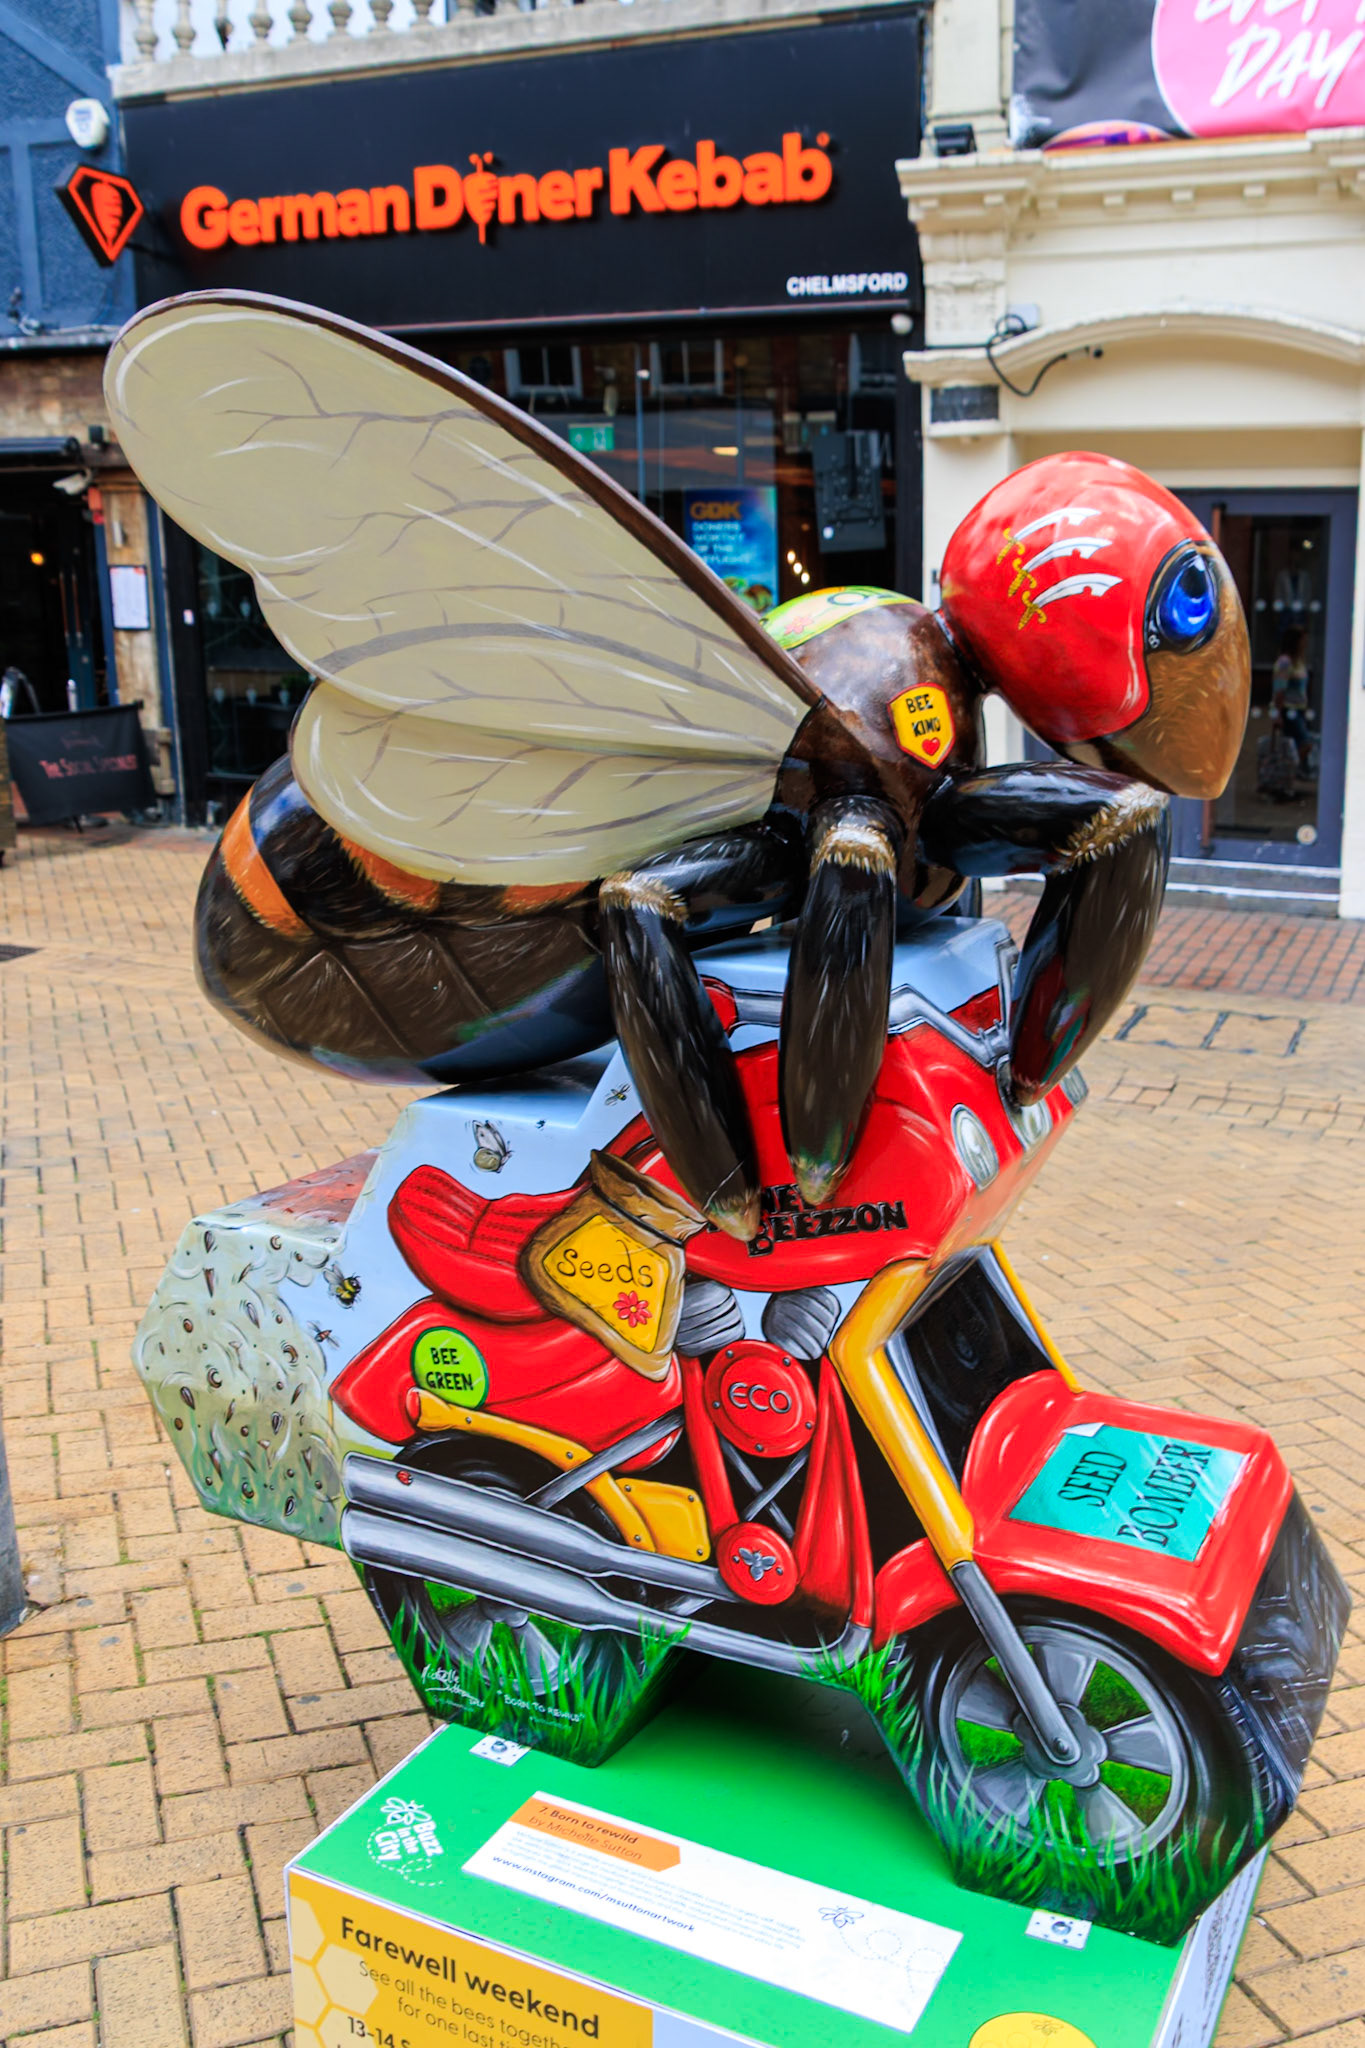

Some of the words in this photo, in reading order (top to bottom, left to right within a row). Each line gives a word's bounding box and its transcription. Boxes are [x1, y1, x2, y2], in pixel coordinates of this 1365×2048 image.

[1209, 23, 1364, 110] DAY
[180, 184, 411, 250] German
[608, 131, 833, 215] Kebab
[786, 272, 908, 297] CHELMSFORD
[690, 501, 741, 520] GDK
[905, 693, 934, 714] BEE
[911, 716, 941, 737] KIND
[556, 1239, 653, 1288] Seeds
[430, 1347, 460, 1365] BEE
[425, 1371, 474, 1391] GREEN
[728, 1381, 792, 1414] ECO
[1057, 1451, 1127, 1507] SEED
[1116, 1443, 1213, 1547] BOMBER
[412, 1821, 445, 1857] Buzz
[528, 1815, 545, 1829] by
[546, 1821, 600, 1845] Michelle
[600, 1839, 643, 1861] Sutton
[550, 1809, 580, 1826] Born
[582, 1820, 595, 1831] to
[595, 1826, 639, 1845] rewild
[375, 1832, 402, 1860] City
[402, 1837, 419, 1854] the
[492, 1854, 696, 1933] www.instagram.com/msuttonartwork
[342, 1916, 456, 1983] Farewell
[464, 1971, 600, 2039] weekend
[359, 1960, 391, 1986] See
[395, 1978, 414, 1996] all
[419, 1986, 447, 2009] the
[452, 1998, 495, 2029] bees
[347, 2016, 395, 2048] 13-14
[398, 1996, 421, 2019] for
[425, 2012, 459, 2036] one
[463, 2024, 495, 2048] last
